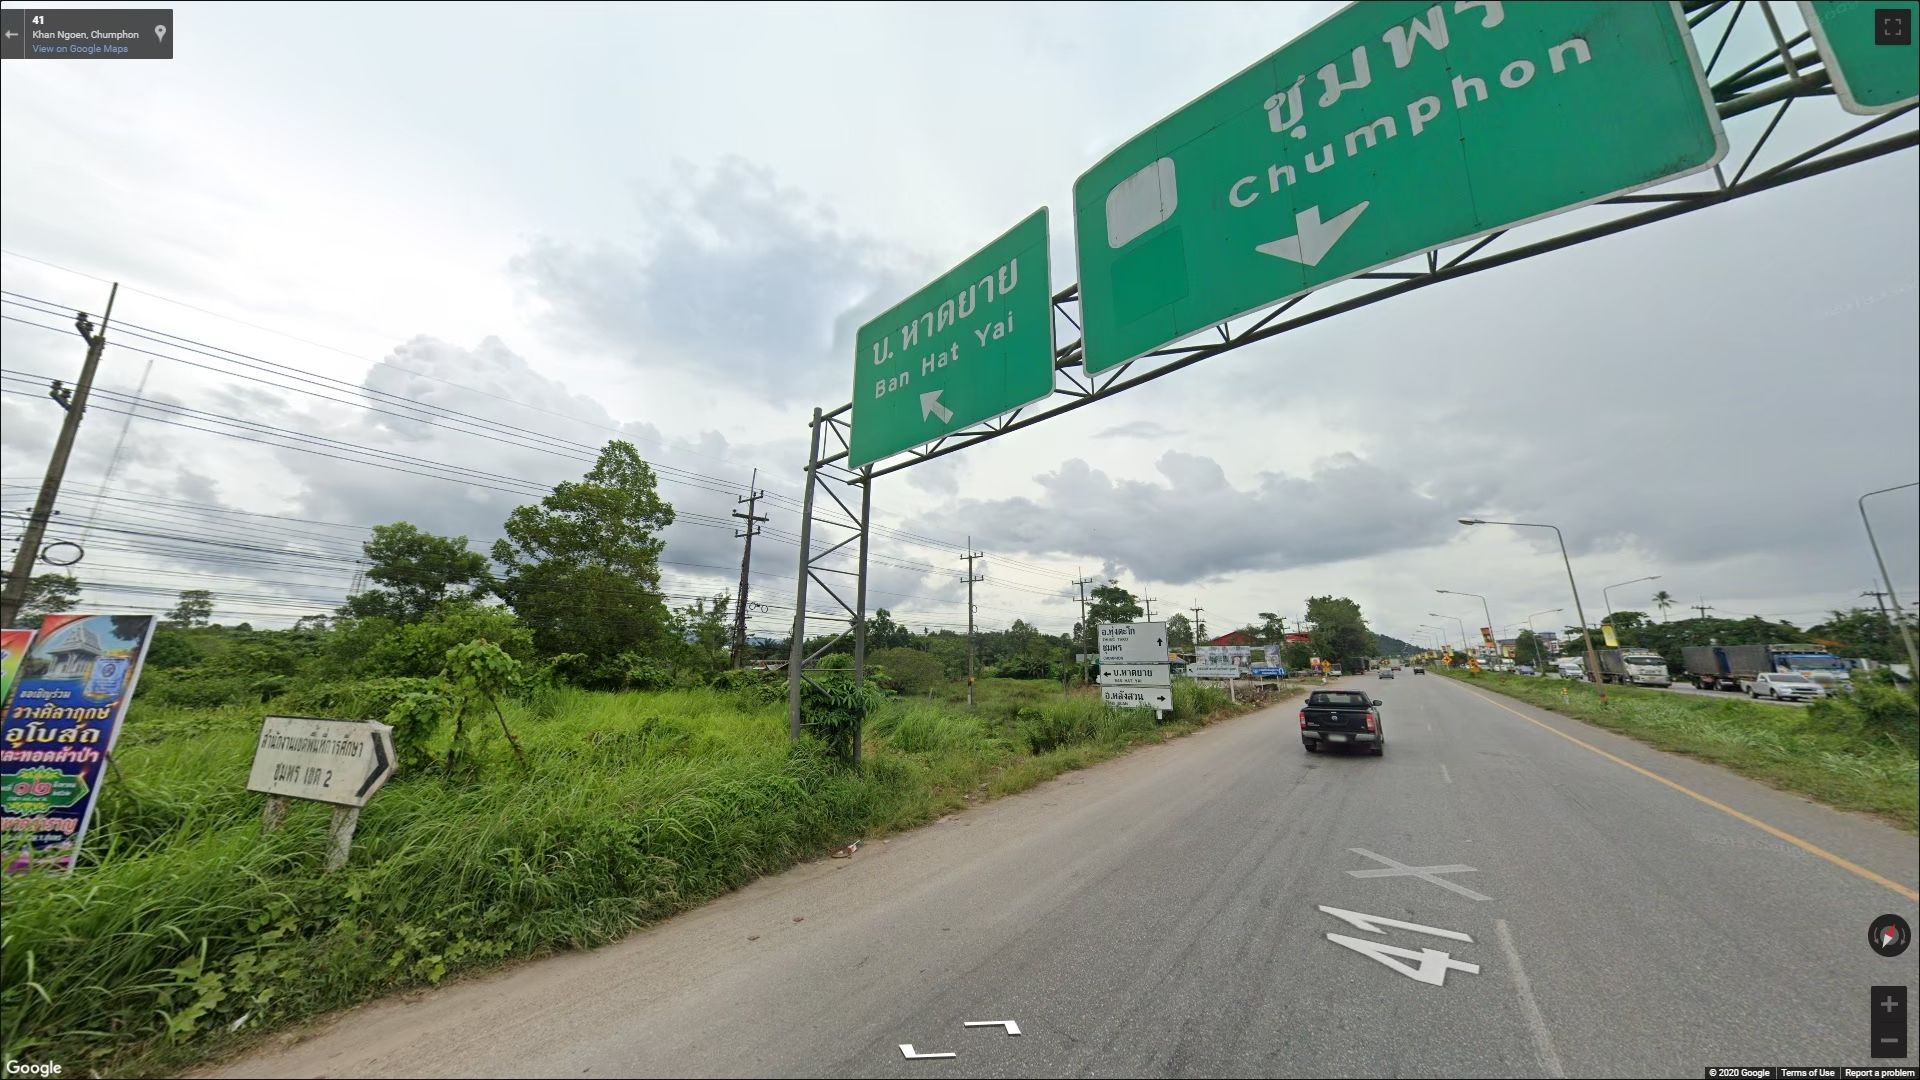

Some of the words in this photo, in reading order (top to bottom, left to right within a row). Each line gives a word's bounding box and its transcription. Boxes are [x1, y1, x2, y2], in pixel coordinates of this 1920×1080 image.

[1229, 37, 1592, 209] Chumphon
[875, 371, 909, 399] Ban
[921, 341, 959, 376] Hat
[974, 311, 1014, 347] Yai
[12, 702, 117, 721] วางศิลาฤกษ์
[273, 762, 300, 788] ชุมพร
[323, 770, 333, 788] 2
